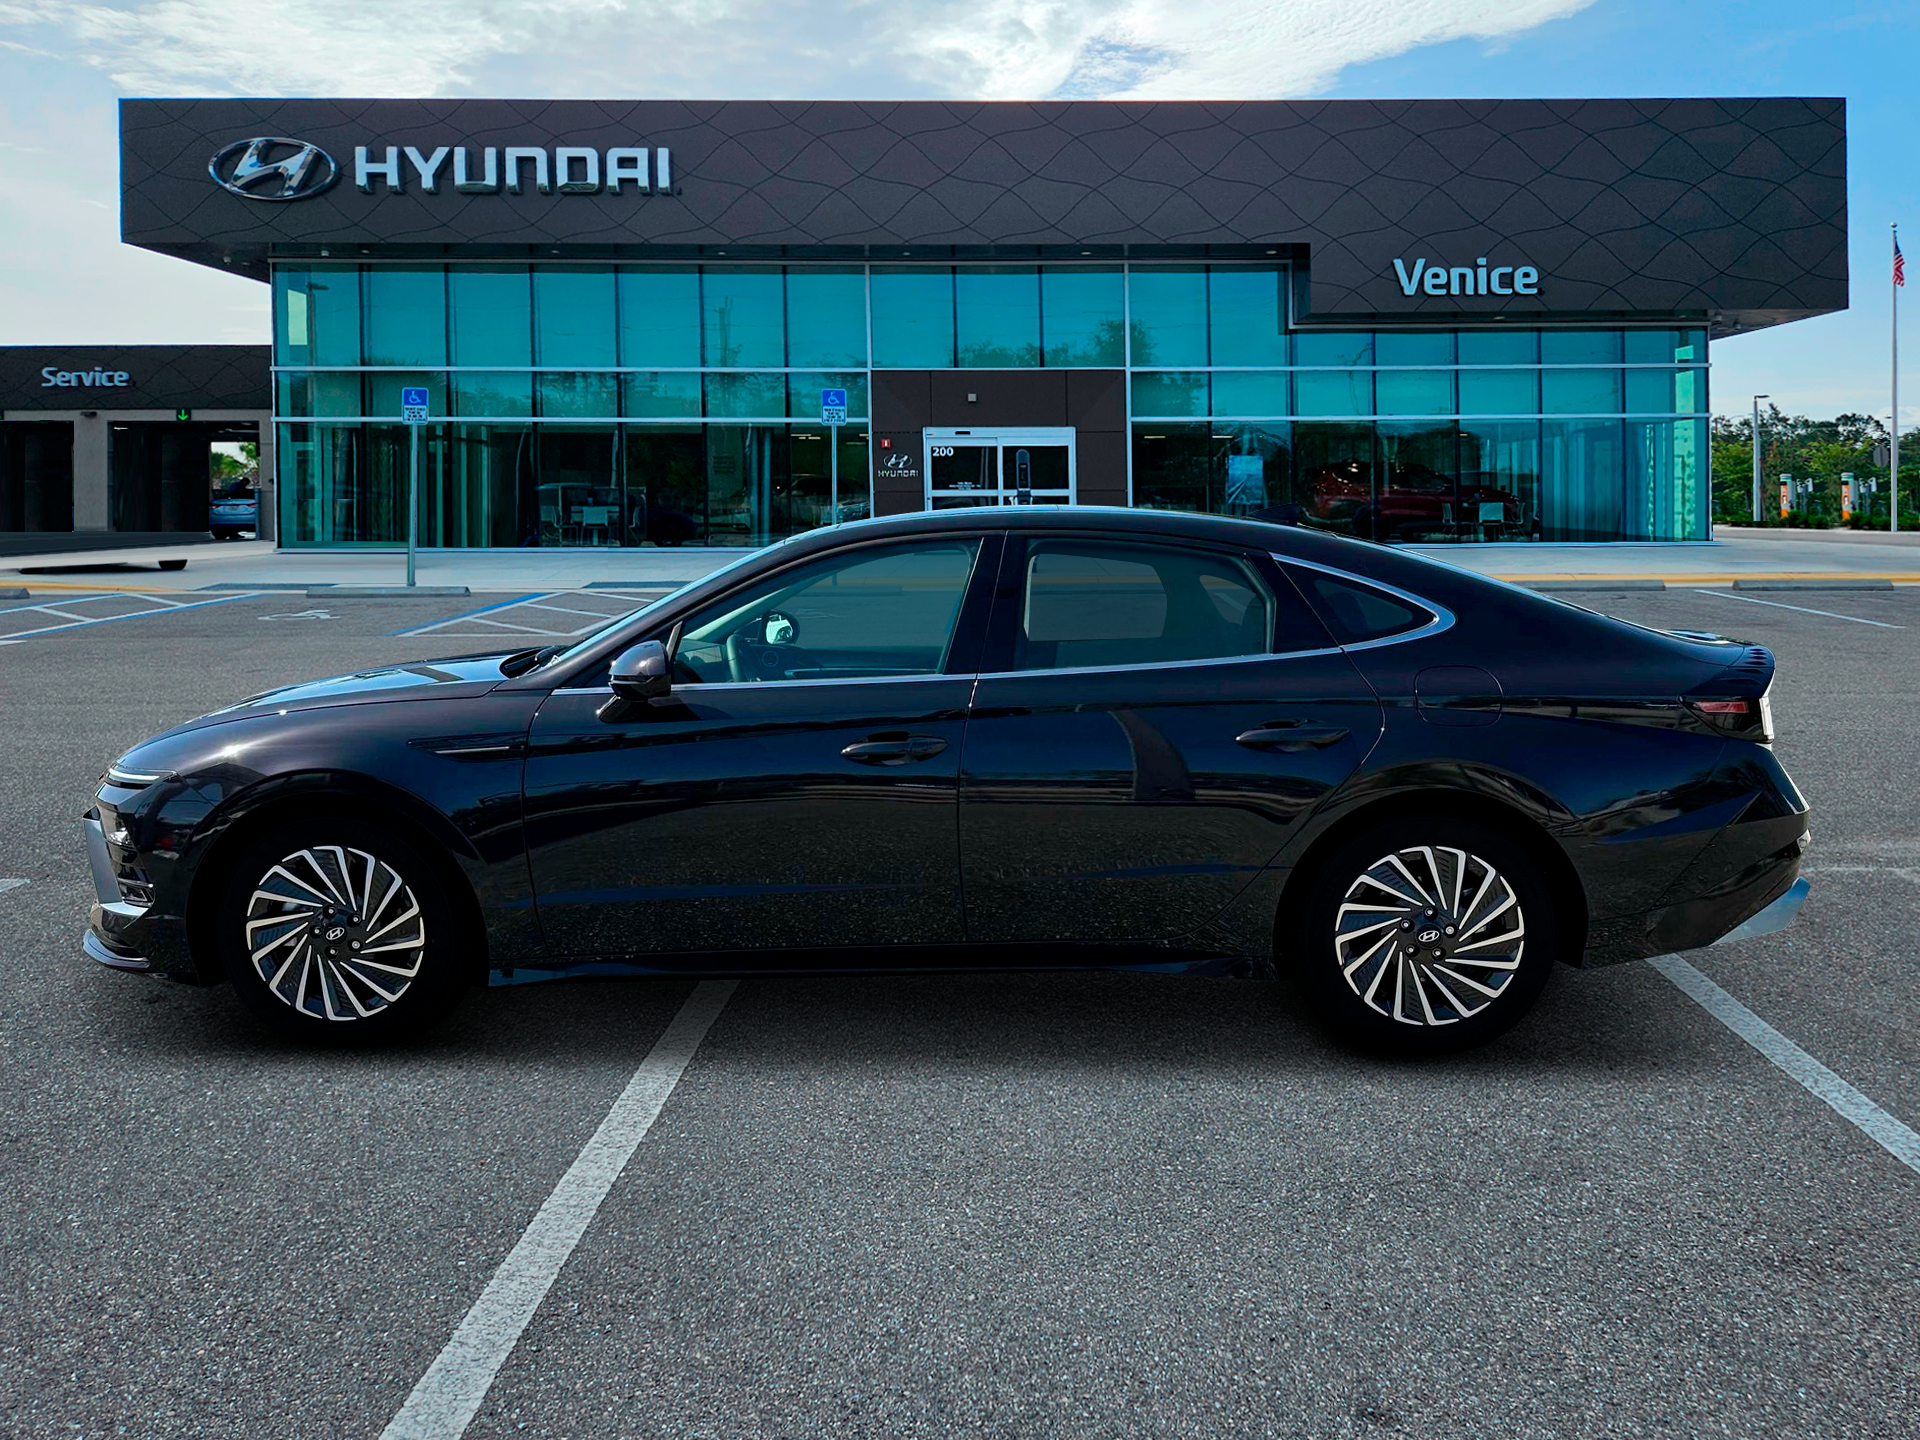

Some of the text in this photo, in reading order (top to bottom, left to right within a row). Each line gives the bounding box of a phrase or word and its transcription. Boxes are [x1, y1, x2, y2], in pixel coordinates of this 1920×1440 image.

[354, 146, 672, 194] HYUNDAI
[1392, 257, 1539, 296] Venice
[41, 366, 130, 387] Service
[932, 446, 954, 457] 200
[877, 469, 919, 478] HYUNDAI
